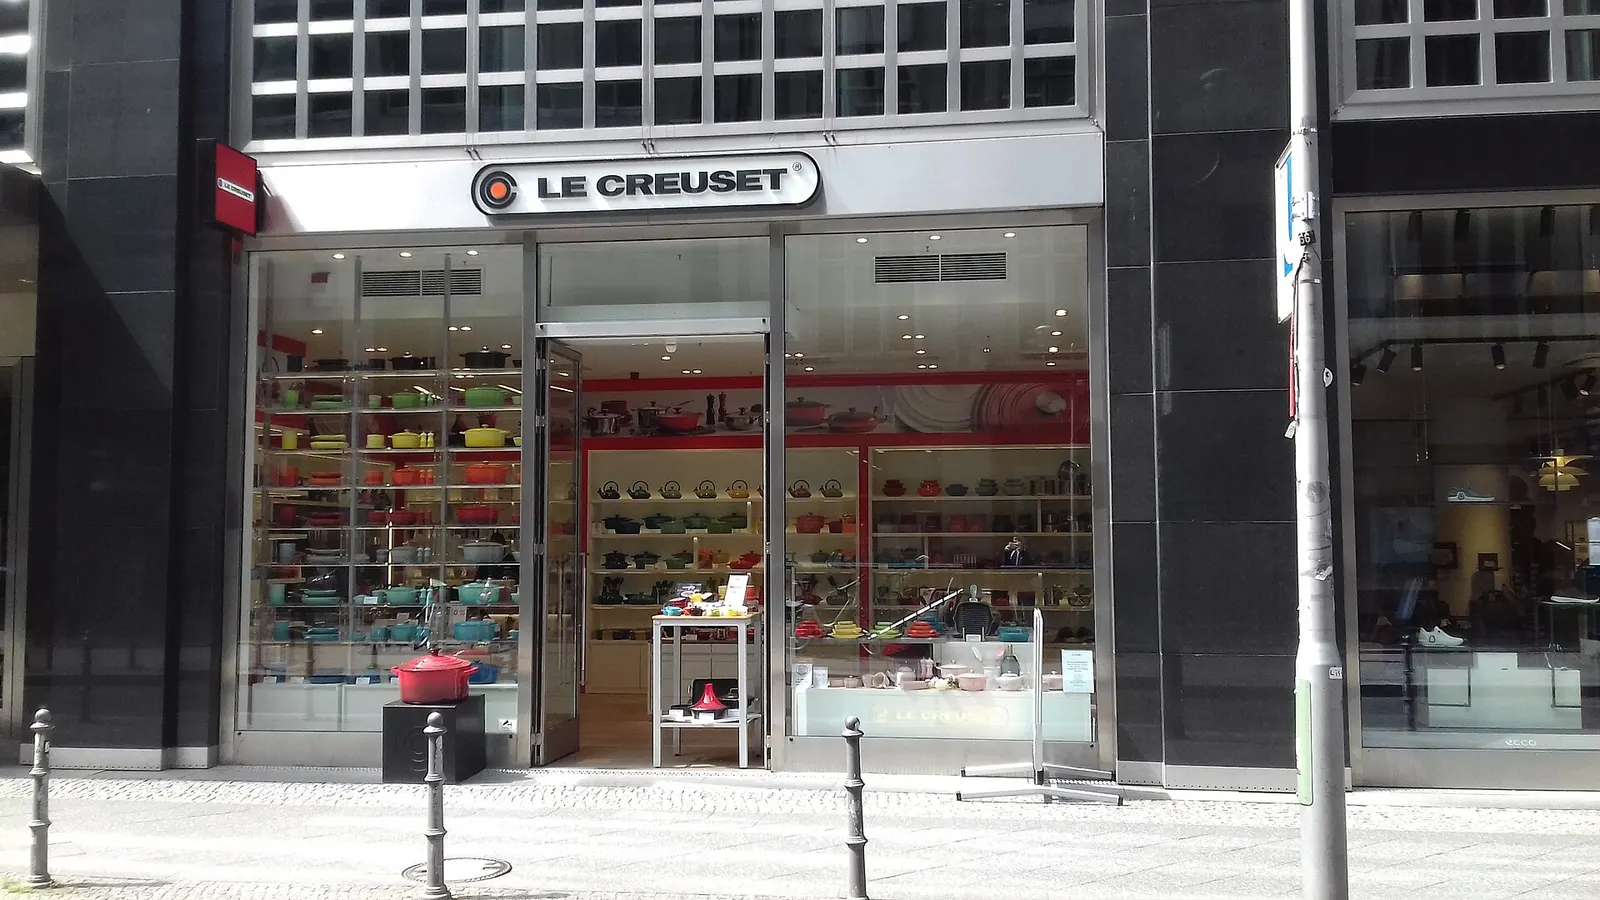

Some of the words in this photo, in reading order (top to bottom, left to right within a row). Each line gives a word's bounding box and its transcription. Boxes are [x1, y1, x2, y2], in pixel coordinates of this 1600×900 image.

[538, 176, 587, 198] LE
[596, 168, 787, 197] CREUSET
[1505, 739, 1537, 747] ecco
